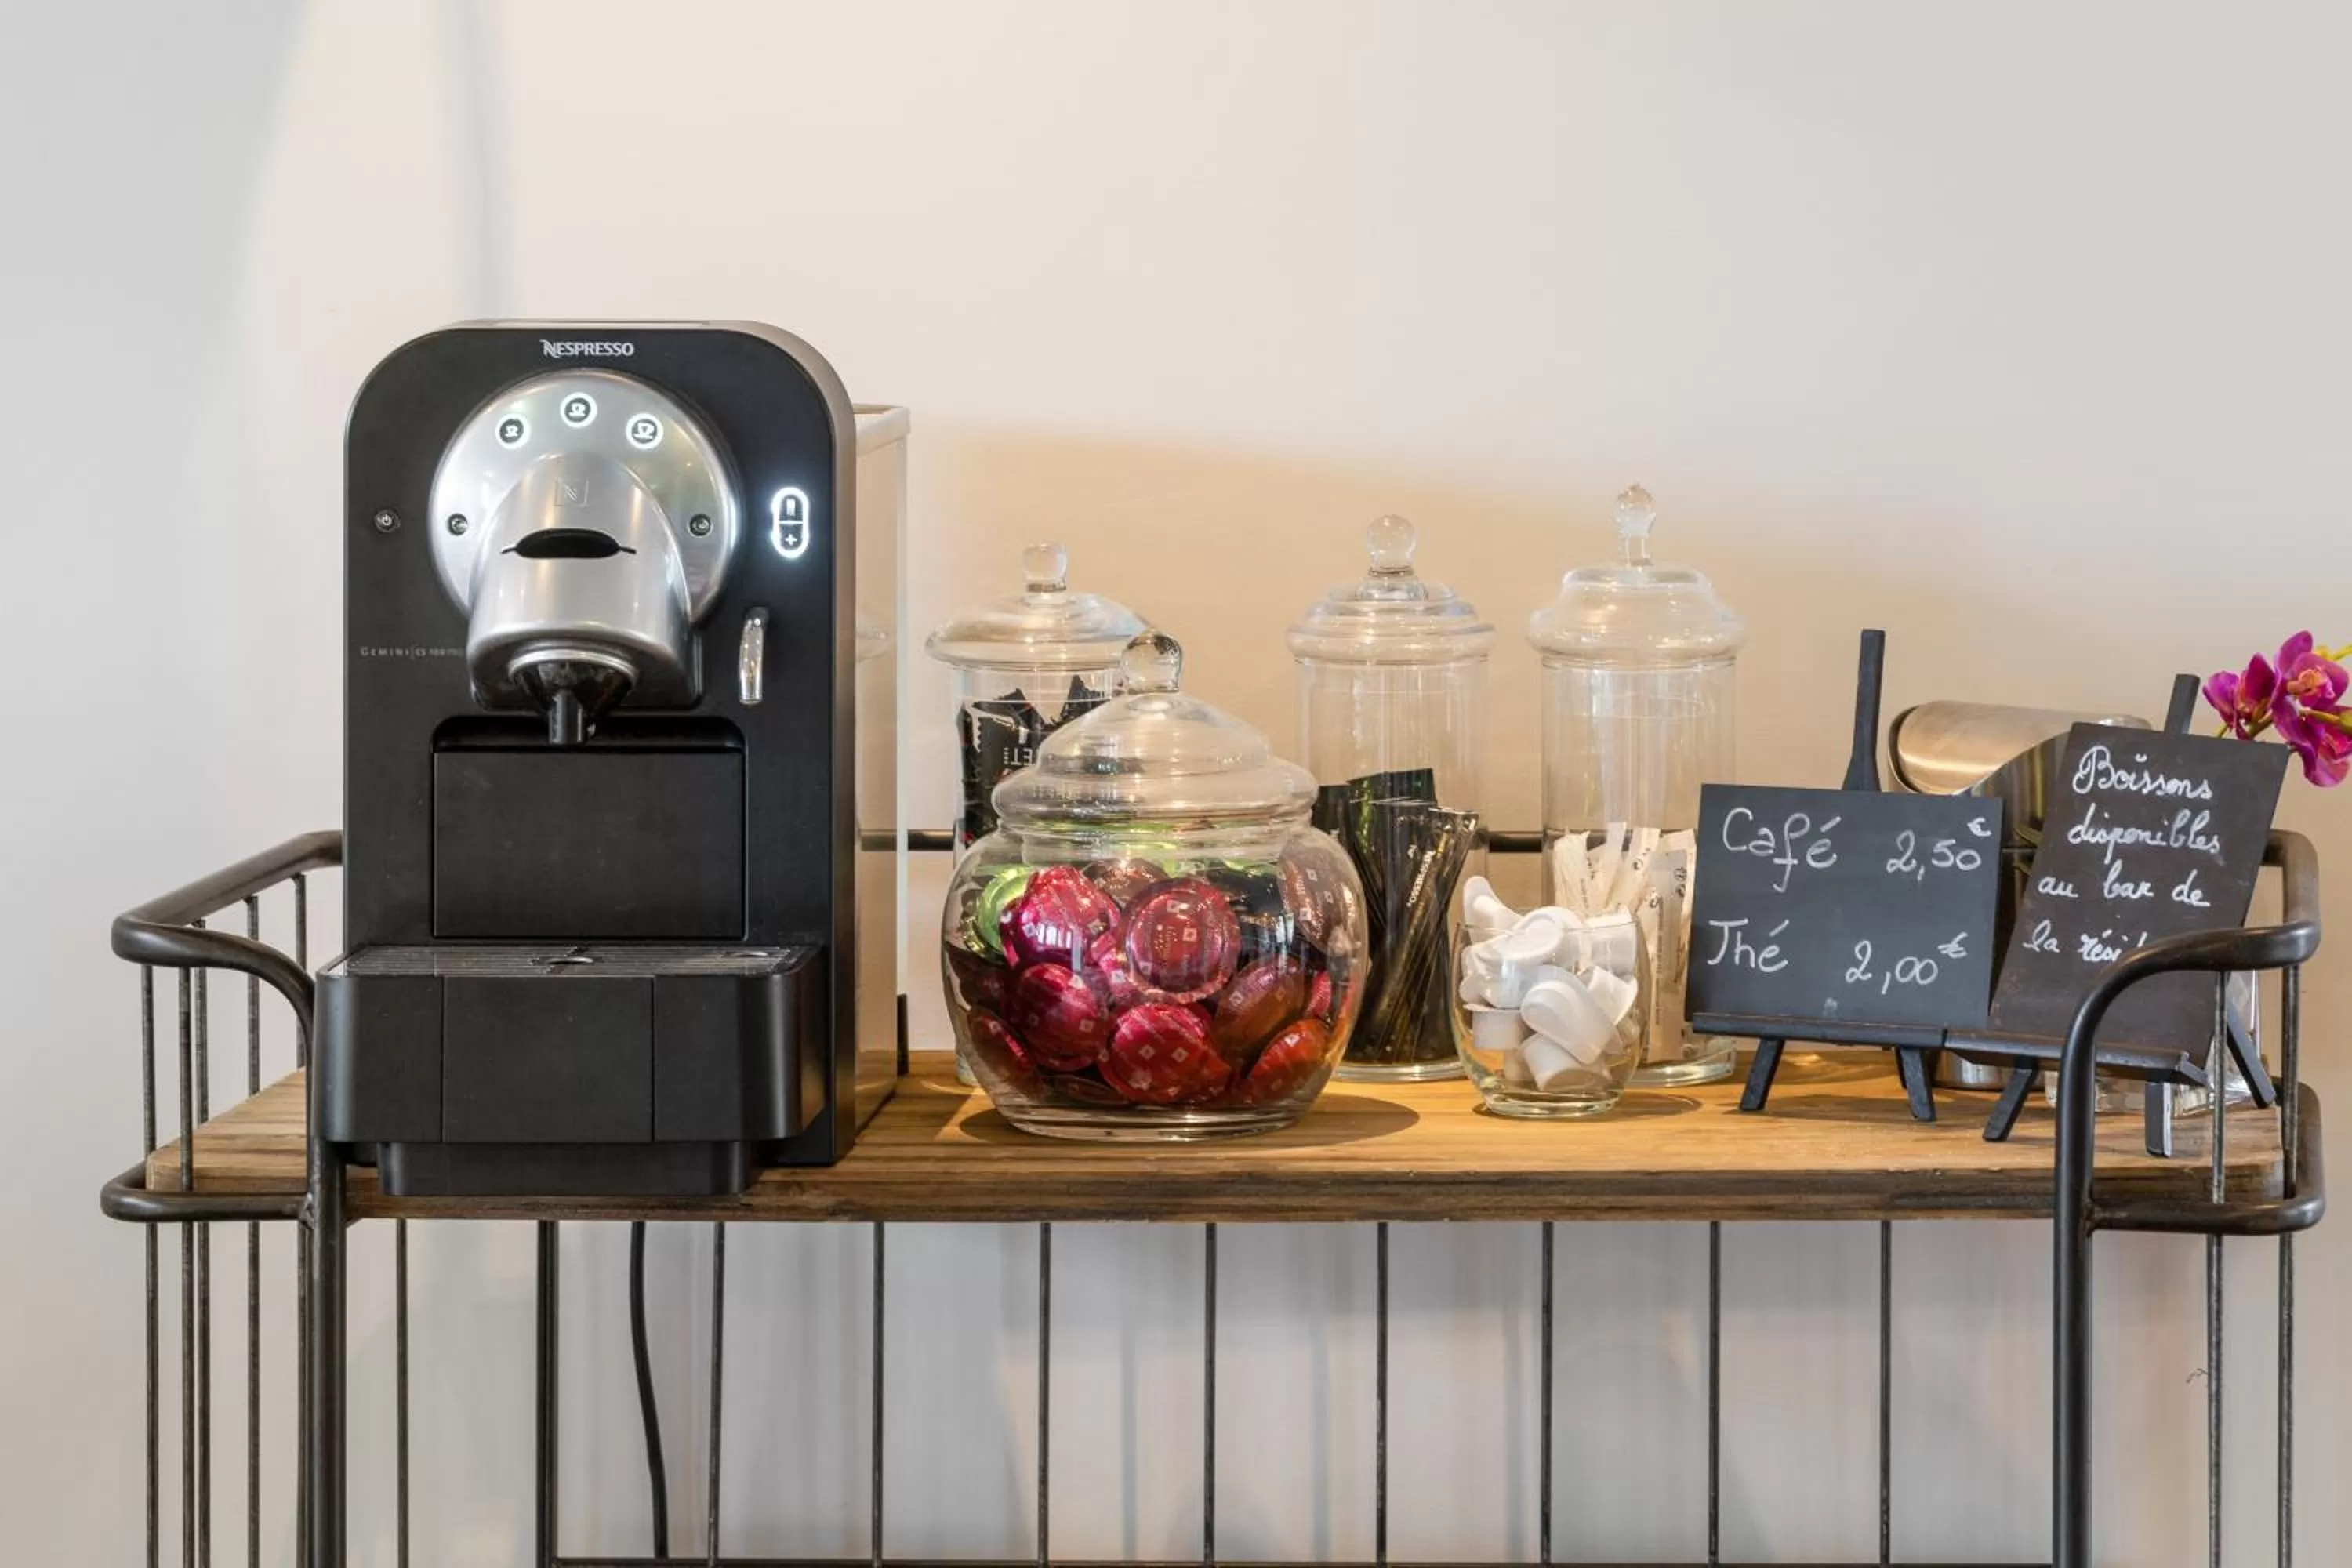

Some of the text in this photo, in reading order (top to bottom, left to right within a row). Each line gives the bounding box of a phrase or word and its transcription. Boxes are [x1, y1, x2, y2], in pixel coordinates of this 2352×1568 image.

[539, 339, 635, 358] NESPRESSO
[2072, 746, 2212, 800] Boissons
[1723, 807, 1991, 892] Café 2,50€
[2067, 803, 2221, 865] disponibles
[2038, 859, 2211, 906] au bar de
[1707, 918, 1790, 972] Thé
[1846, 932, 1968, 995] 2,00€
[2022, 920, 2148, 963] la rési
